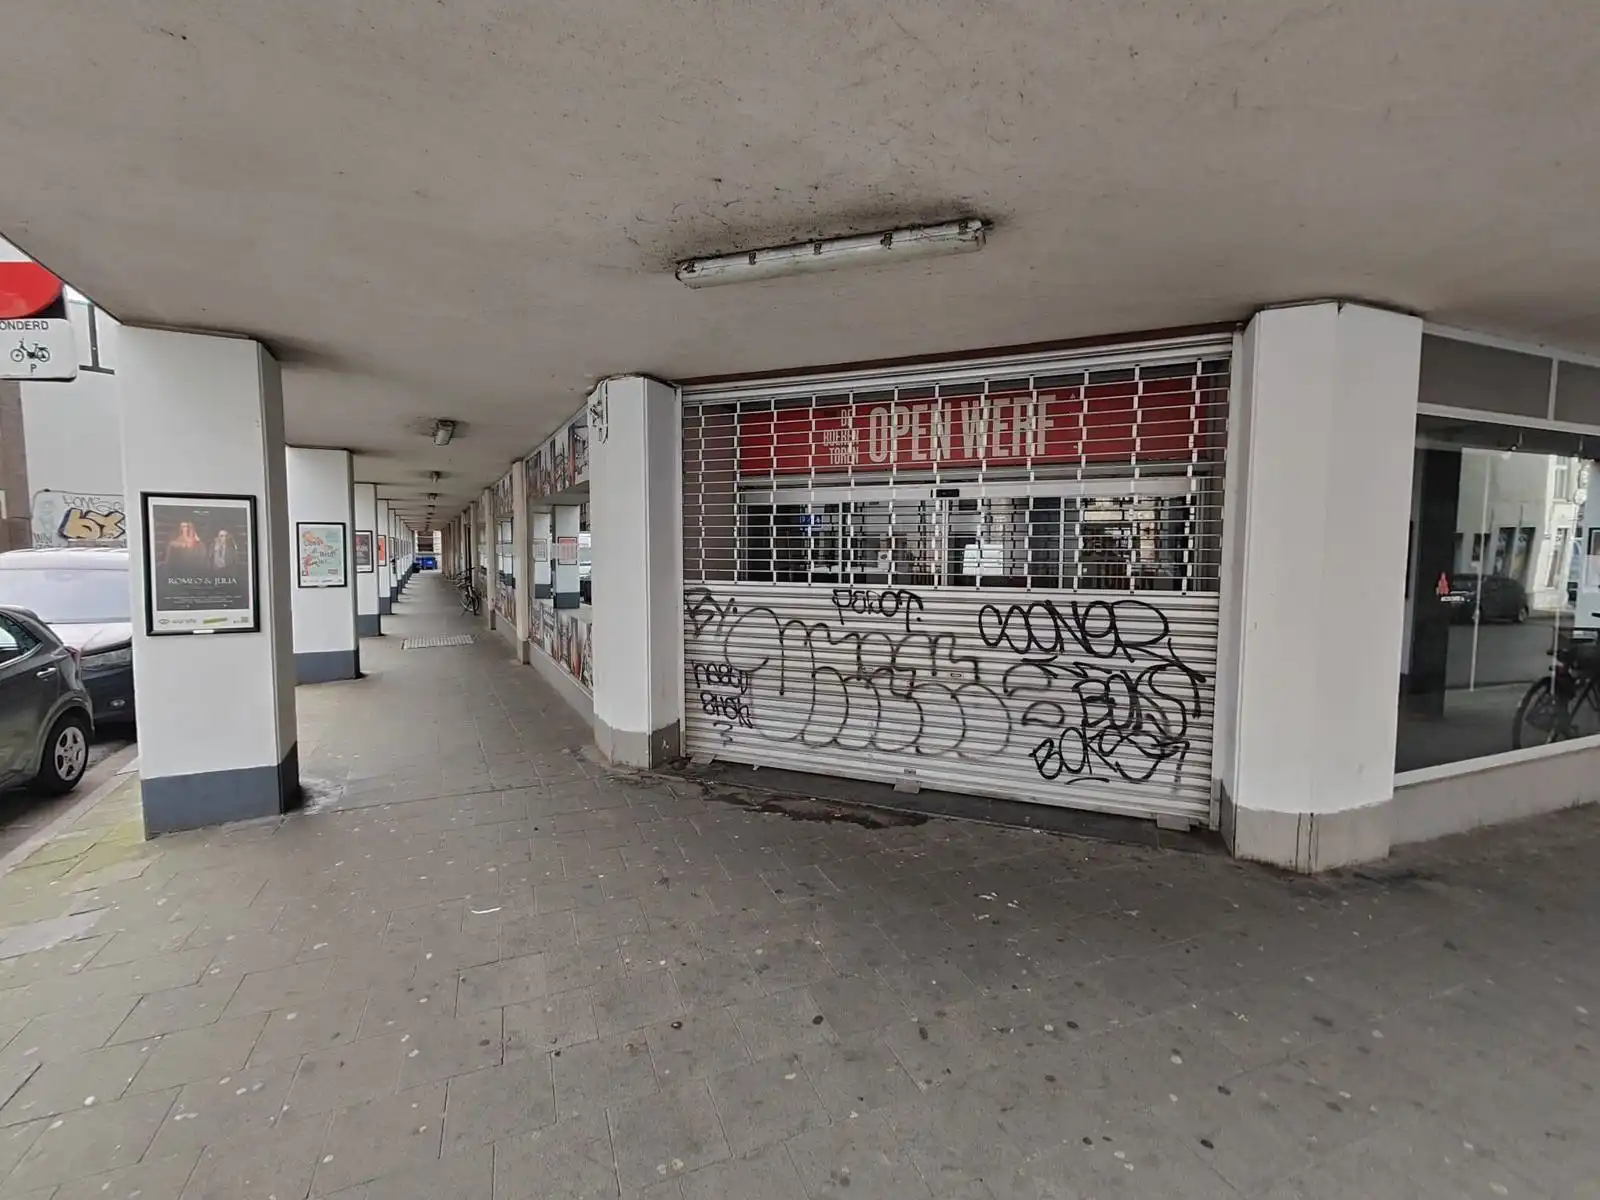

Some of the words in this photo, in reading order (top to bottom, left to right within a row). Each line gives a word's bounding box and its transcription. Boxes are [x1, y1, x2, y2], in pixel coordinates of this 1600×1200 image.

[30, 363, 38, 374] P
[868, 401, 952, 464] OPEN
[960, 394, 1057, 459] WERF
[168, 577, 202, 585] ROMEO
[214, 577, 239, 586] JULIA
